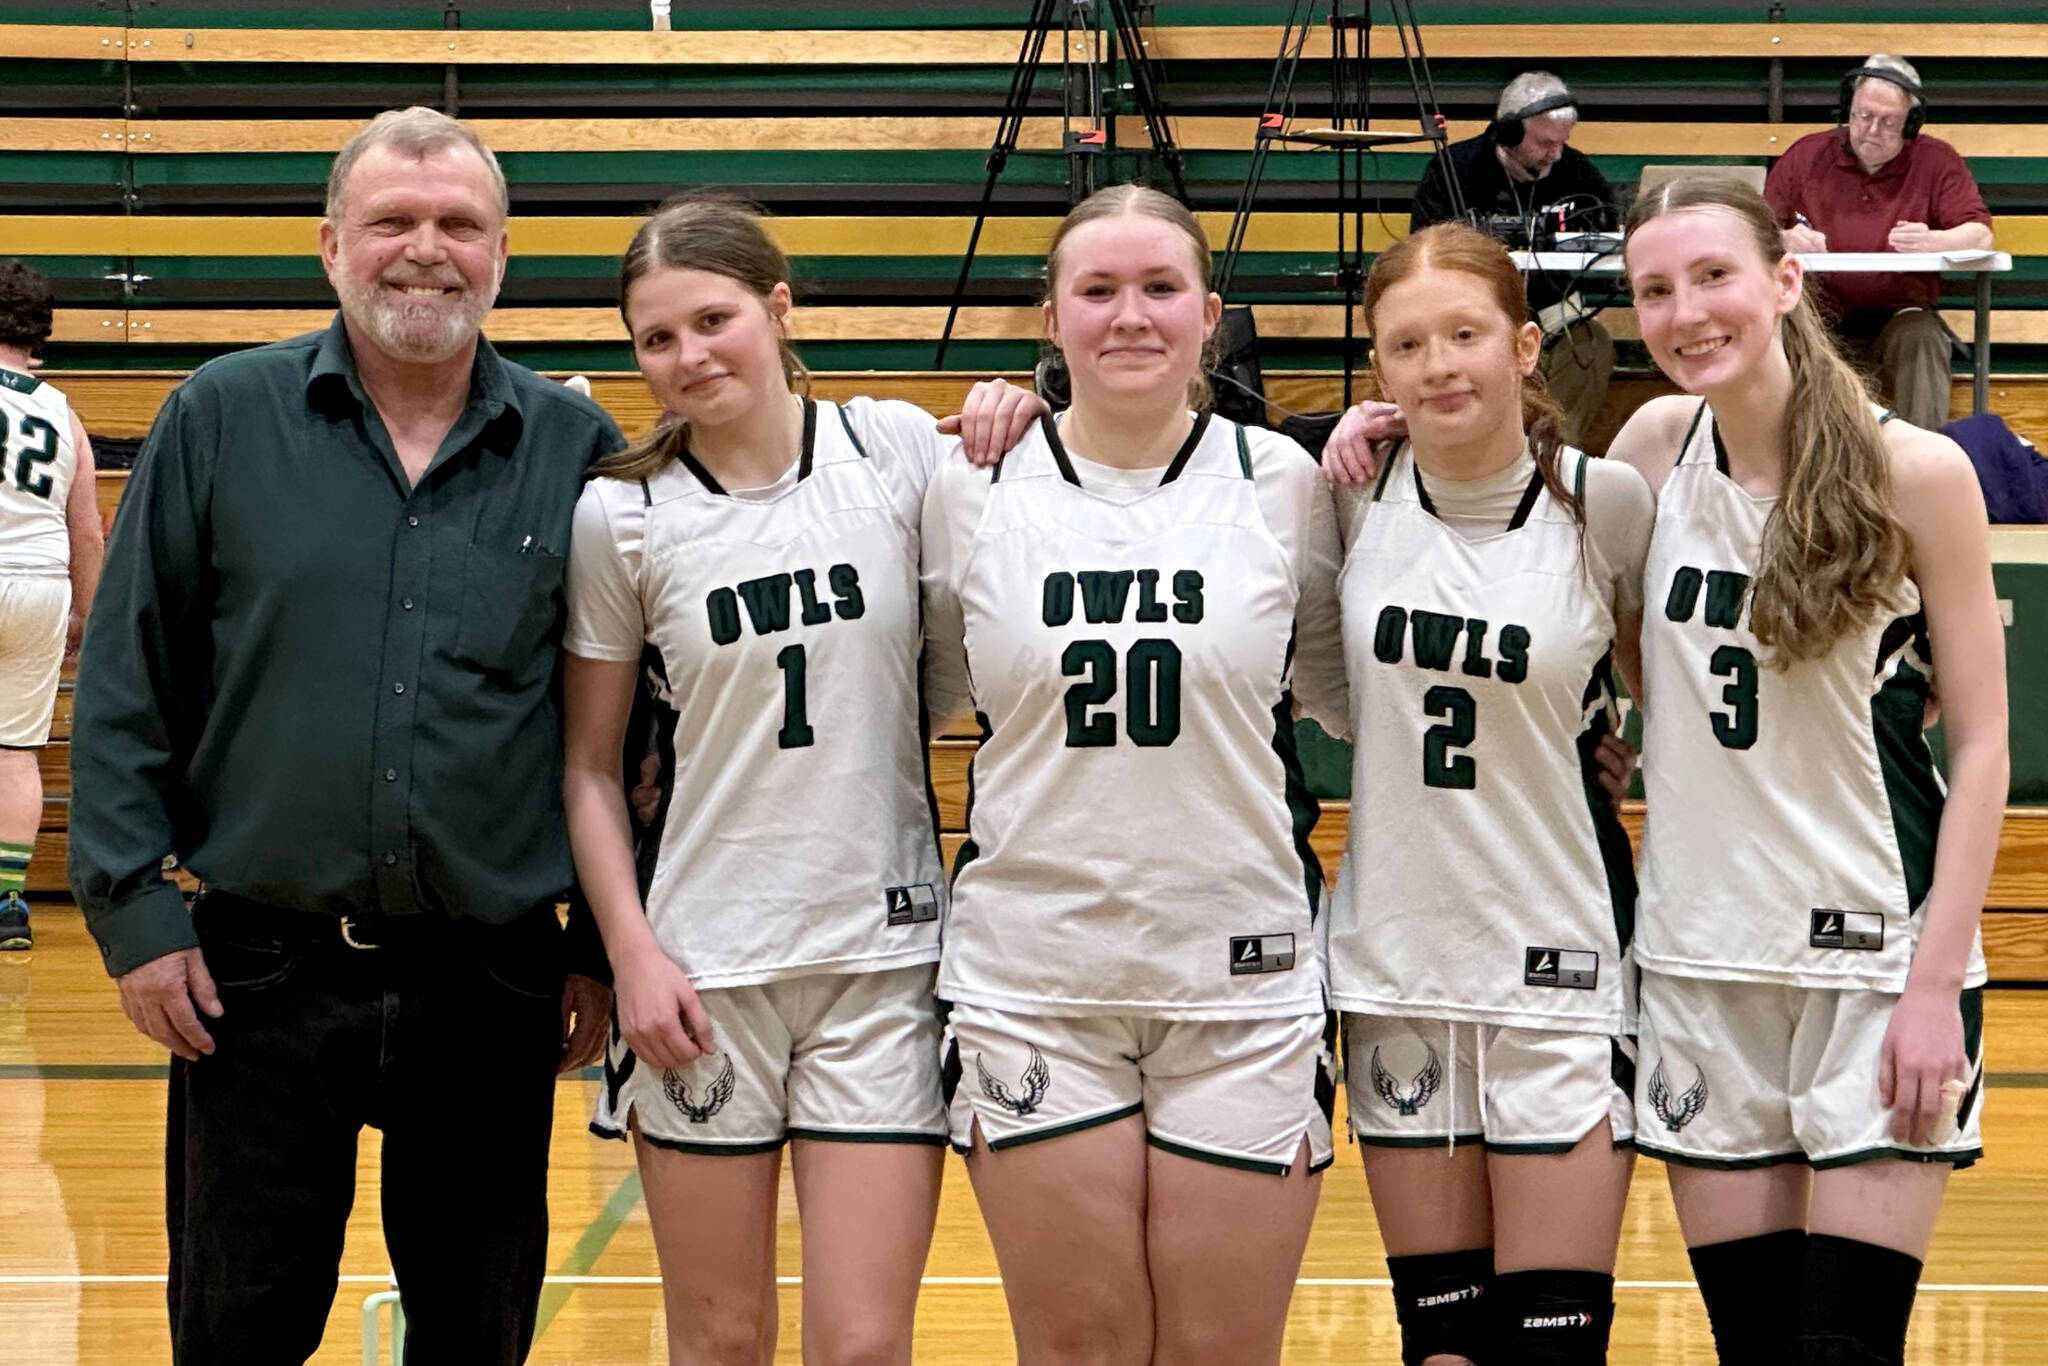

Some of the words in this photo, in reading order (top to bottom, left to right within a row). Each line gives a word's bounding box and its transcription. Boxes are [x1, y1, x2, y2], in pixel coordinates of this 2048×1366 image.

[0, 407, 59, 501] 2
[706, 563, 865, 646] OWLS
[1043, 569, 1204, 627] OWLS
[1665, 566, 1757, 634] OW
[1374, 605, 1531, 684] OWLS
[777, 643, 814, 749] 1
[1061, 638, 1182, 747] 20
[1709, 645, 1759, 751] 3
[1424, 685, 1476, 790] 2
[1276, 956, 1283, 967] L
[1572, 972, 1582, 983] S
[1858, 934, 1867, 944] S
